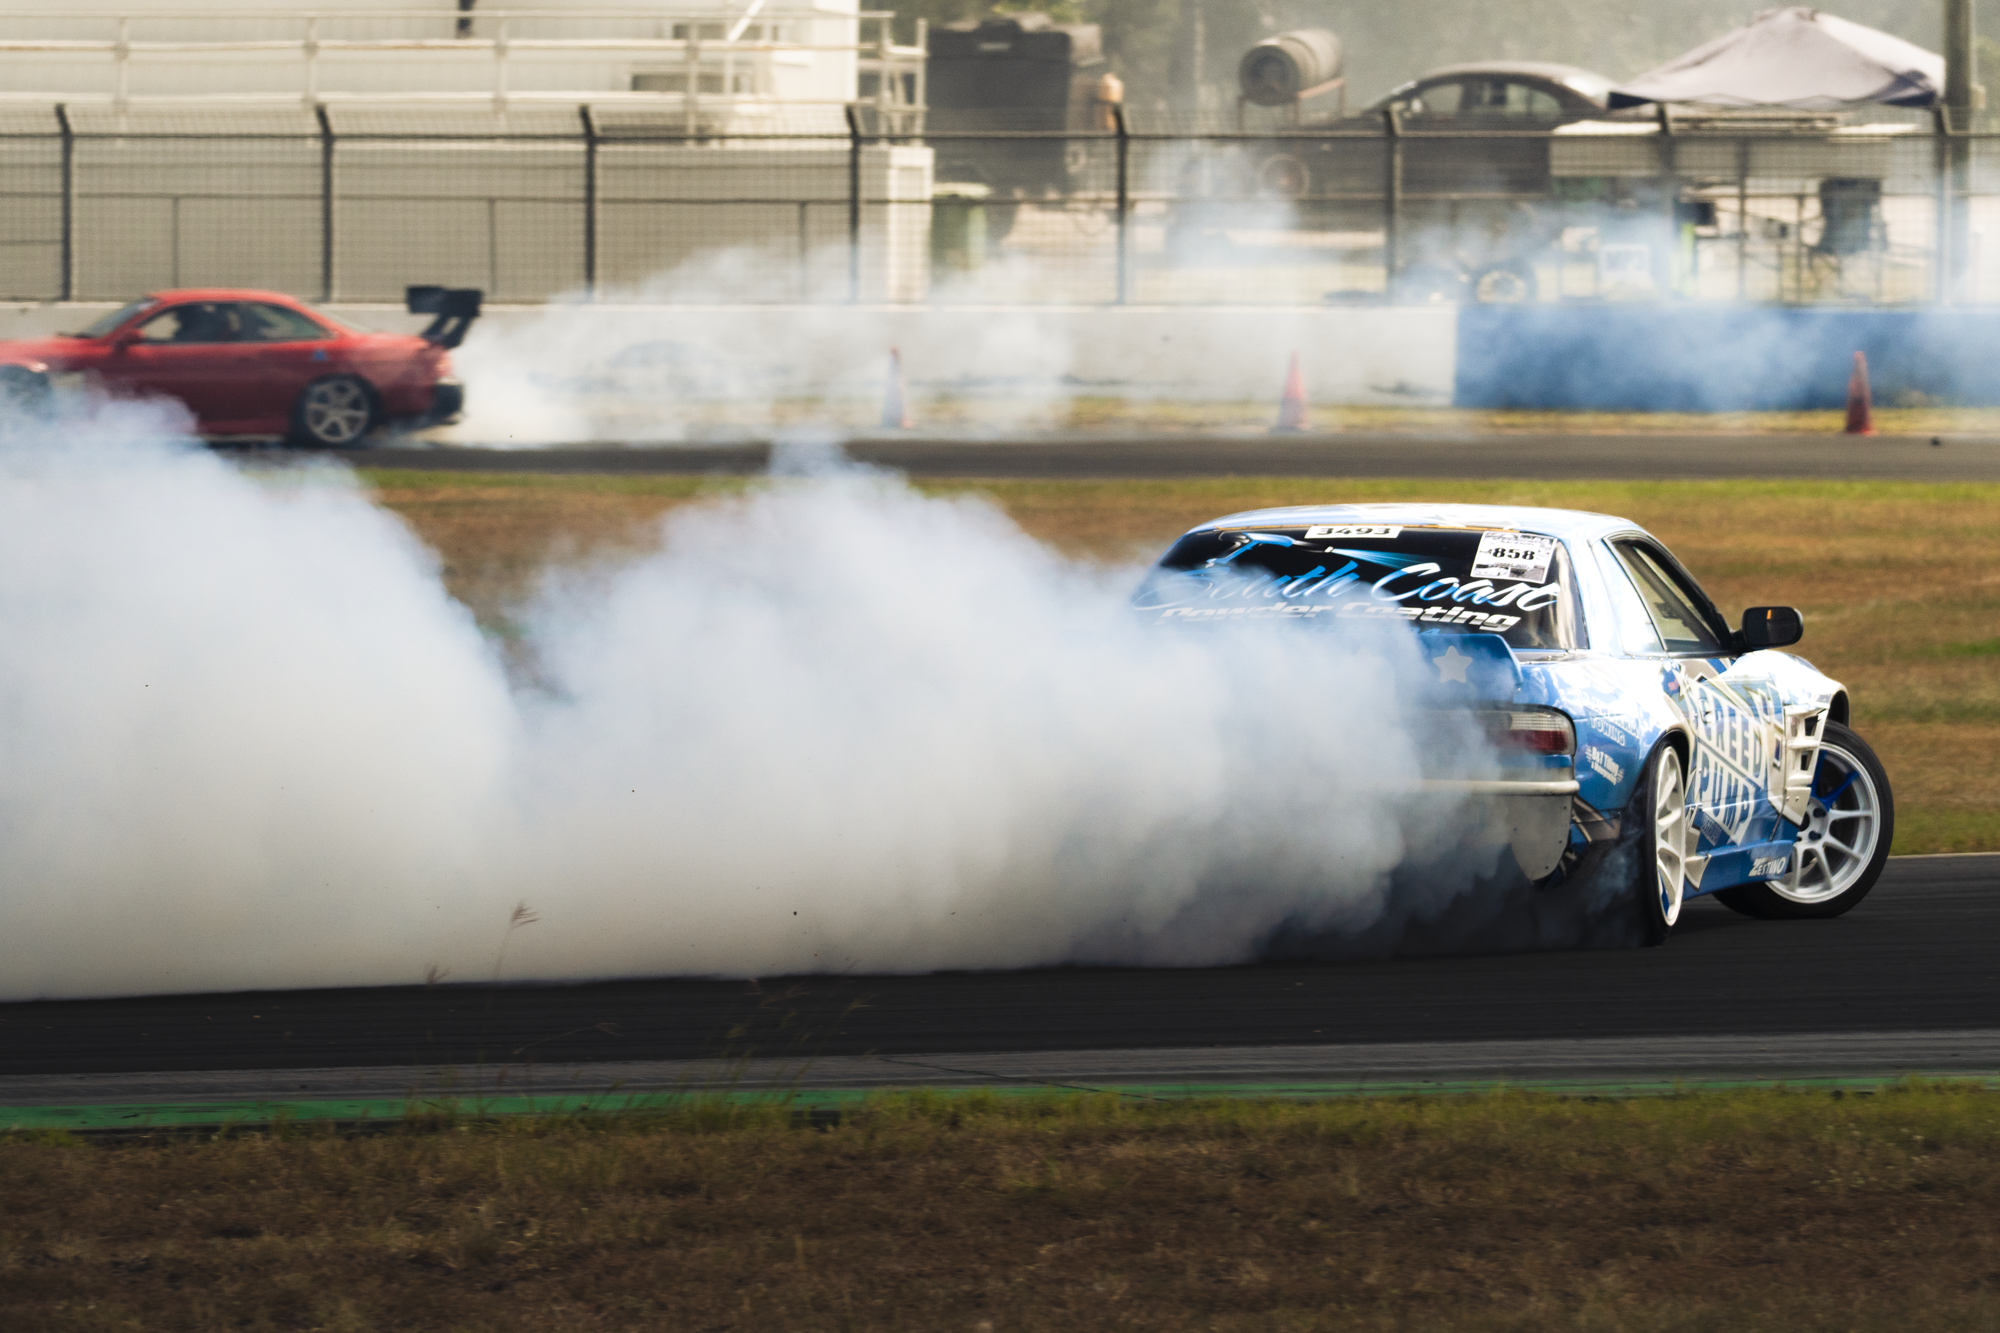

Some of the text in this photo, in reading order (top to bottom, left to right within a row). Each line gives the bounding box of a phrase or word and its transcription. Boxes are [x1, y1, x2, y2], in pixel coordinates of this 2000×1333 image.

[1317, 526, 1392, 536] 3493
[1492, 547, 1536, 561] 858
[1133, 560, 1560, 612] South Coast
[1152, 601, 1334, 626] Powder
[1335, 601, 1521, 632] Coating
[1700, 750, 1751, 835] PUMP
